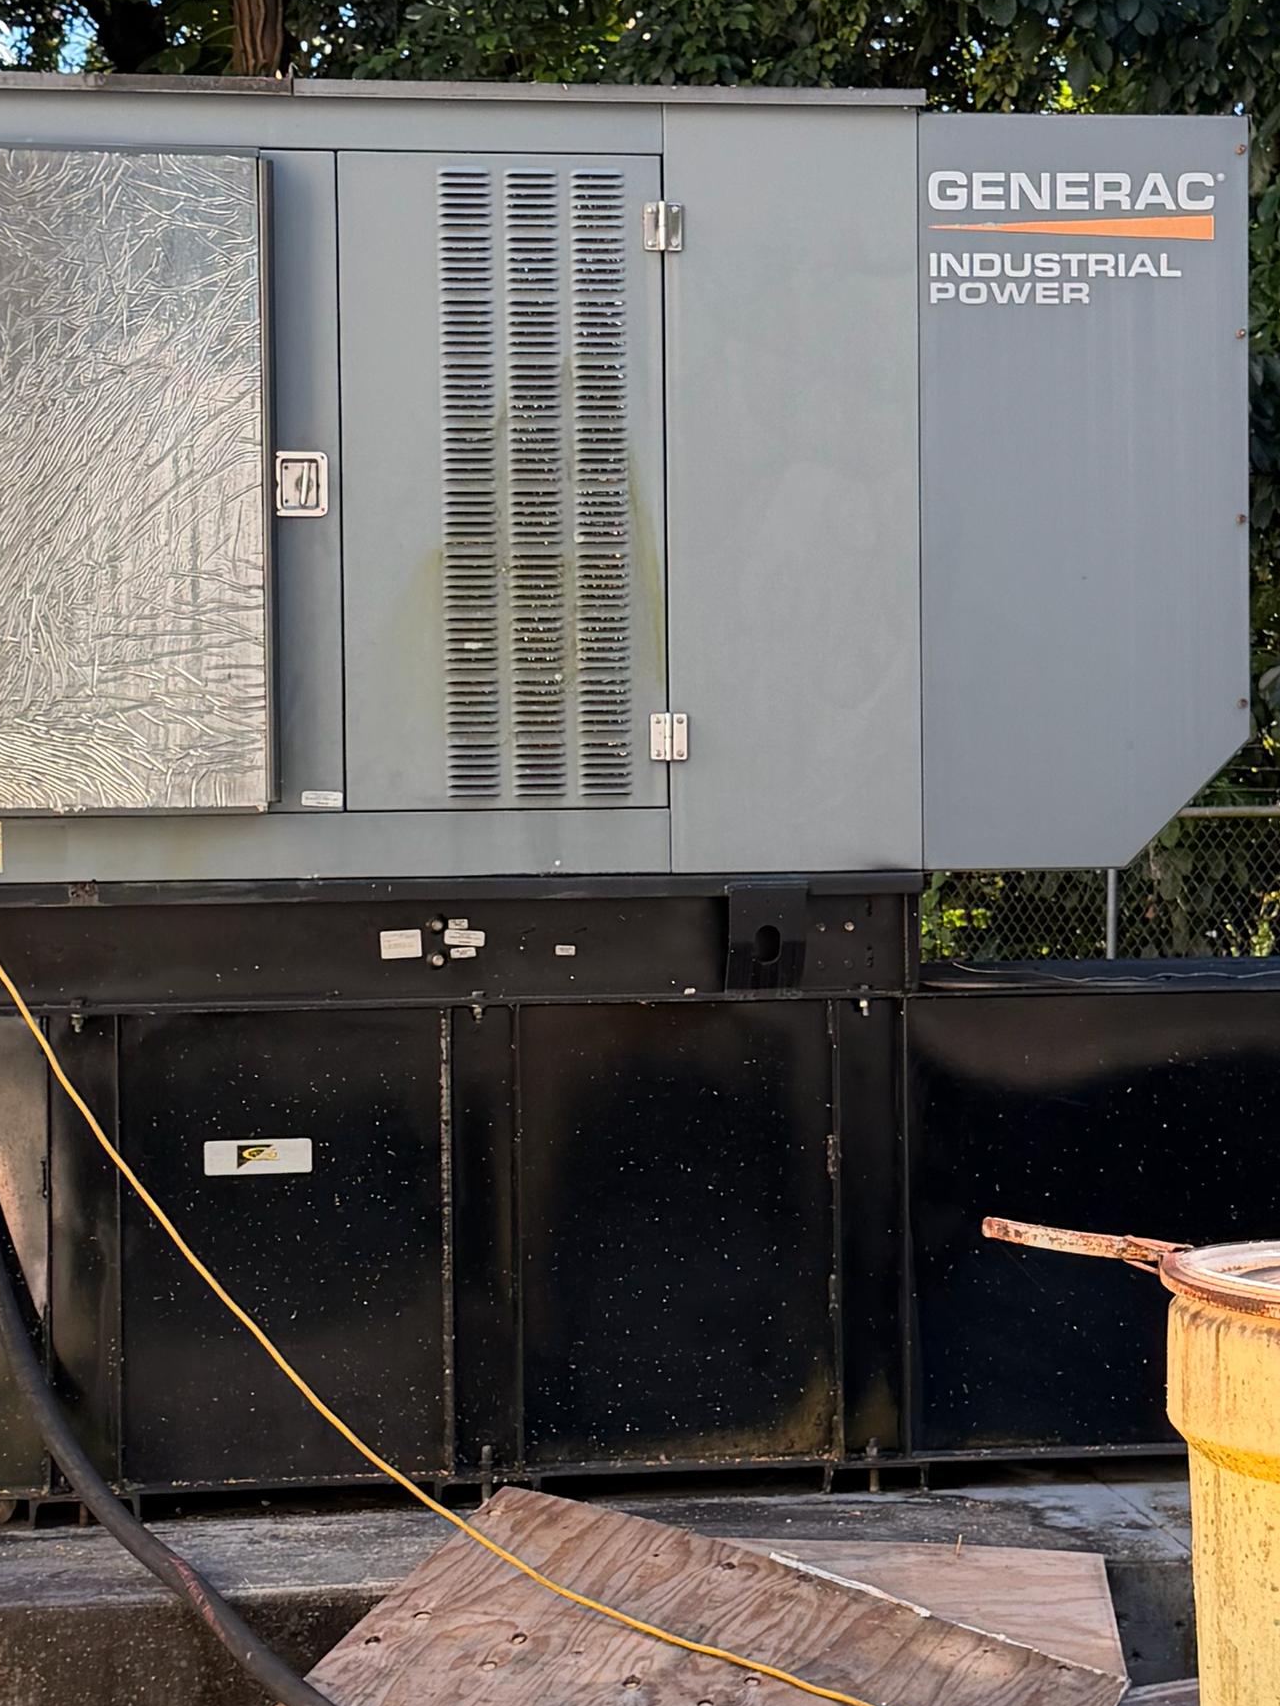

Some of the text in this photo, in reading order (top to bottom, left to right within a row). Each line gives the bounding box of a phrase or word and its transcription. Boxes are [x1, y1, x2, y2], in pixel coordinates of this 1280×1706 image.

[927, 171, 1215, 211] GENERAC
[928, 253, 1182, 278] INDUSTRIAL
[929, 282, 1090, 305] POWER
